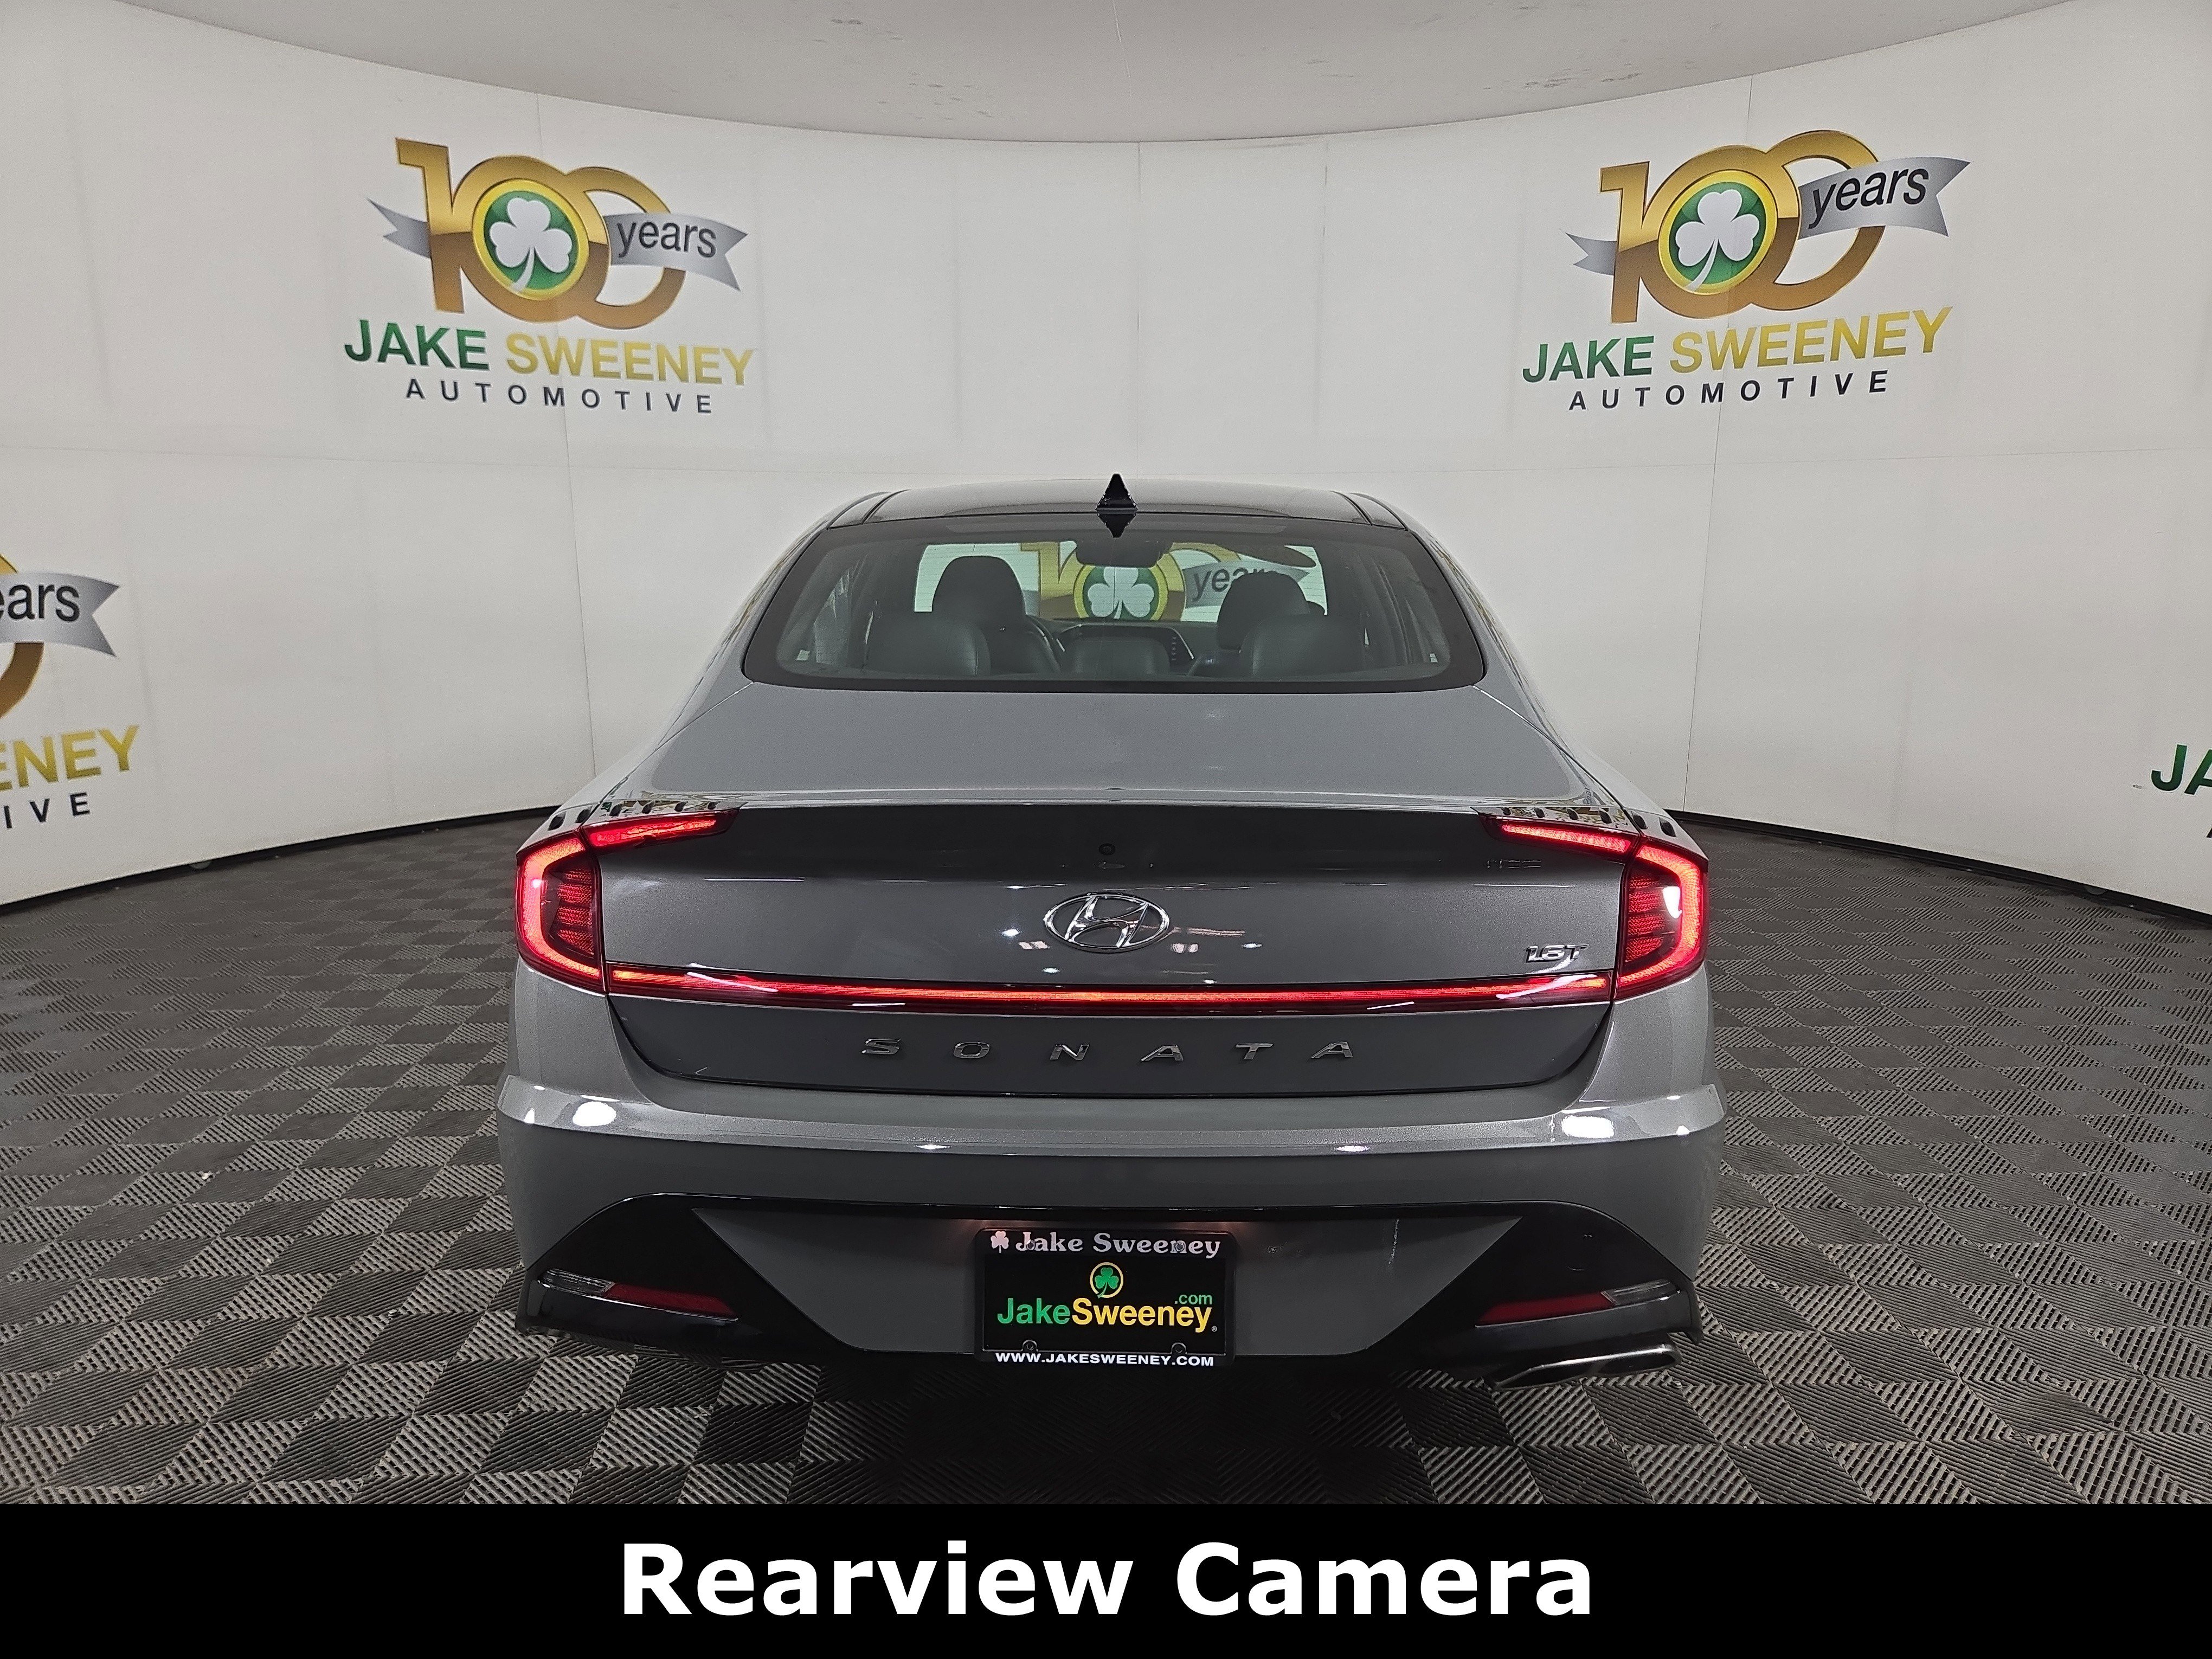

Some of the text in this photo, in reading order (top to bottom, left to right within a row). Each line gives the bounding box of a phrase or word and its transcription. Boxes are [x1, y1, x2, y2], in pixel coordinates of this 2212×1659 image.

[1808, 168, 1929, 229] years
[395, 138, 686, 330] 100
[616, 221, 717, 259] years
[1599, 130, 1887, 324] 100
[345, 319, 753, 385] JAKE SWEENEY
[1523, 306, 1953, 384] JAKE SWEENEY
[406, 378, 712, 414] AUTOMOTIVE
[1569, 370, 1889, 411] AUTOMOTIVE
[0, 584, 80, 622] ars
[2151, 743, 2212, 795] JA
[861, 1038, 1353, 1062] SONATA
[1015, 1232, 1221, 1259] Jake Sweeney
[995, 1352, 1214, 1366] WWW.JAKESWEENEY.COM
